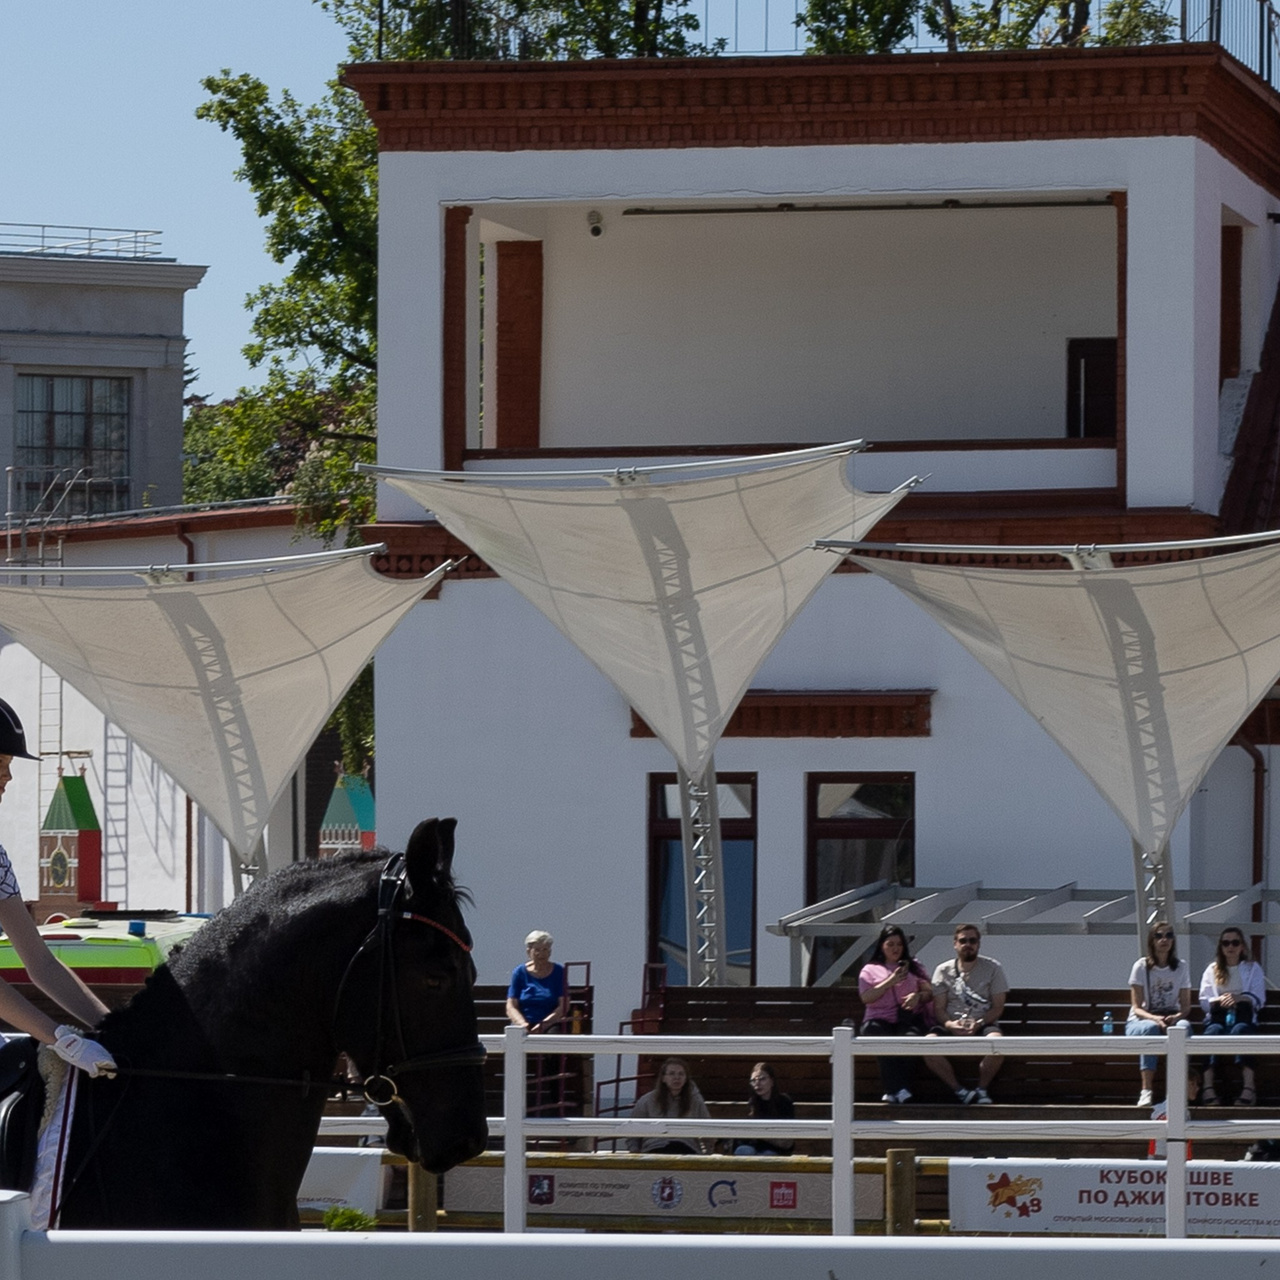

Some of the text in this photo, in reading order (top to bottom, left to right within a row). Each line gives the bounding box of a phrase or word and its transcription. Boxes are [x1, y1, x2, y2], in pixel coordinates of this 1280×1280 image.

[1099, 1169, 1234, 1186] КУБОК ШВЕ
[1078, 1189, 1259, 1207] ПО ДЖИТОВКЕ
